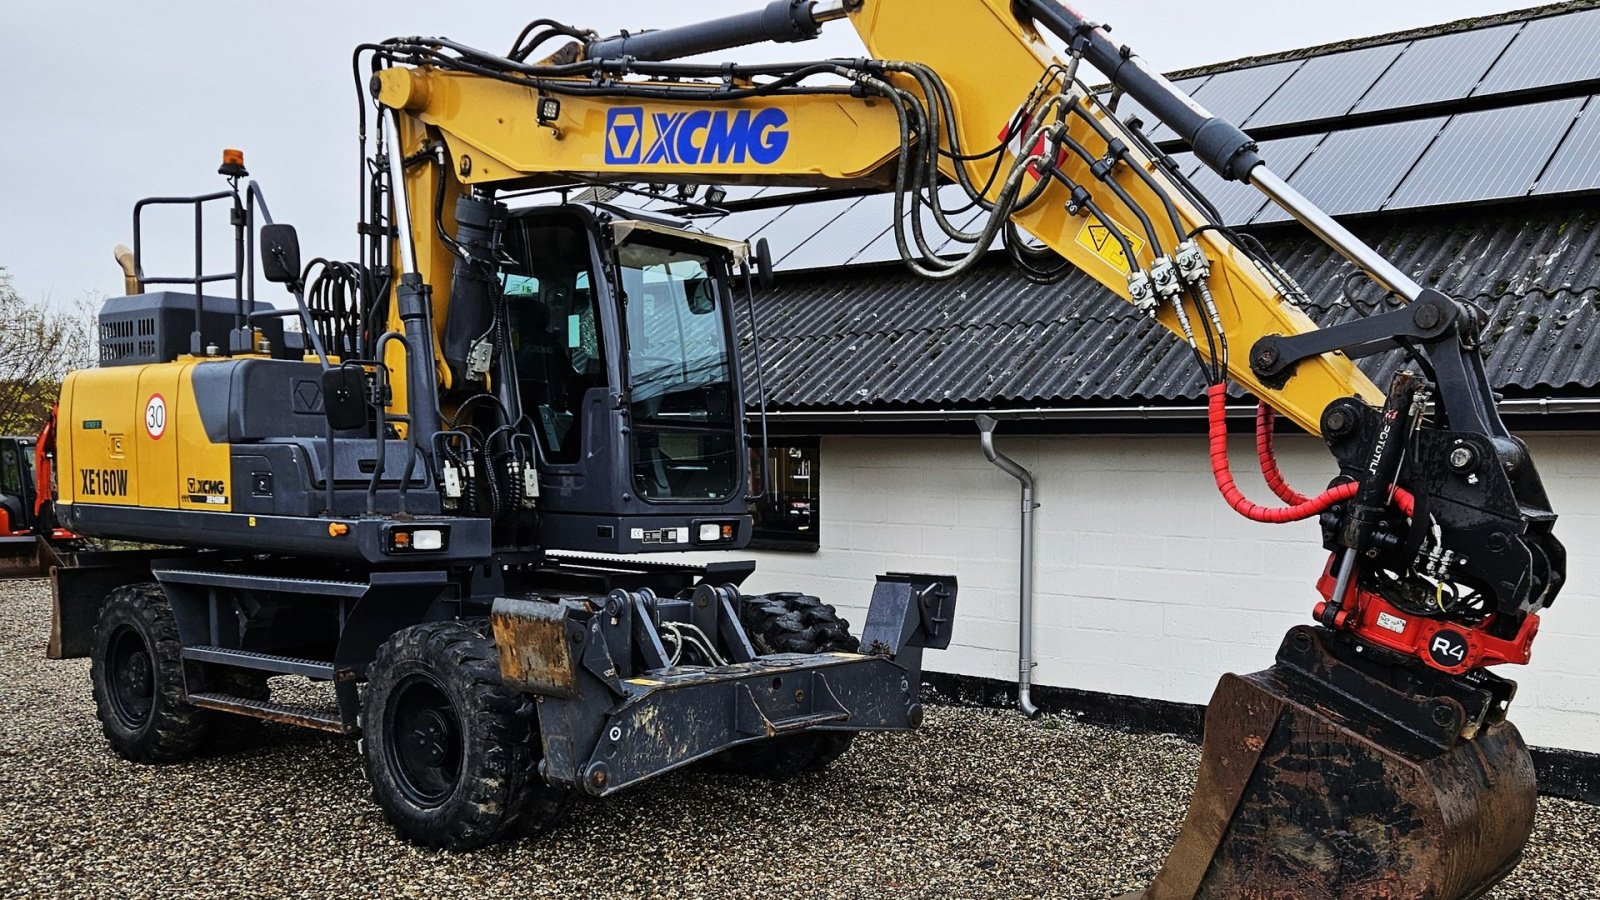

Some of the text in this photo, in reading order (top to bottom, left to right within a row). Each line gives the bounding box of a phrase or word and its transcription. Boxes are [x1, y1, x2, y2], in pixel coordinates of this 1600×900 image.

[641, 107, 789, 165] XCMG
[148, 405, 164, 428] 30
[81, 469, 128, 496] XE160W
[197, 480, 225, 495] XCMG
[1432, 637, 1464, 661] R4
